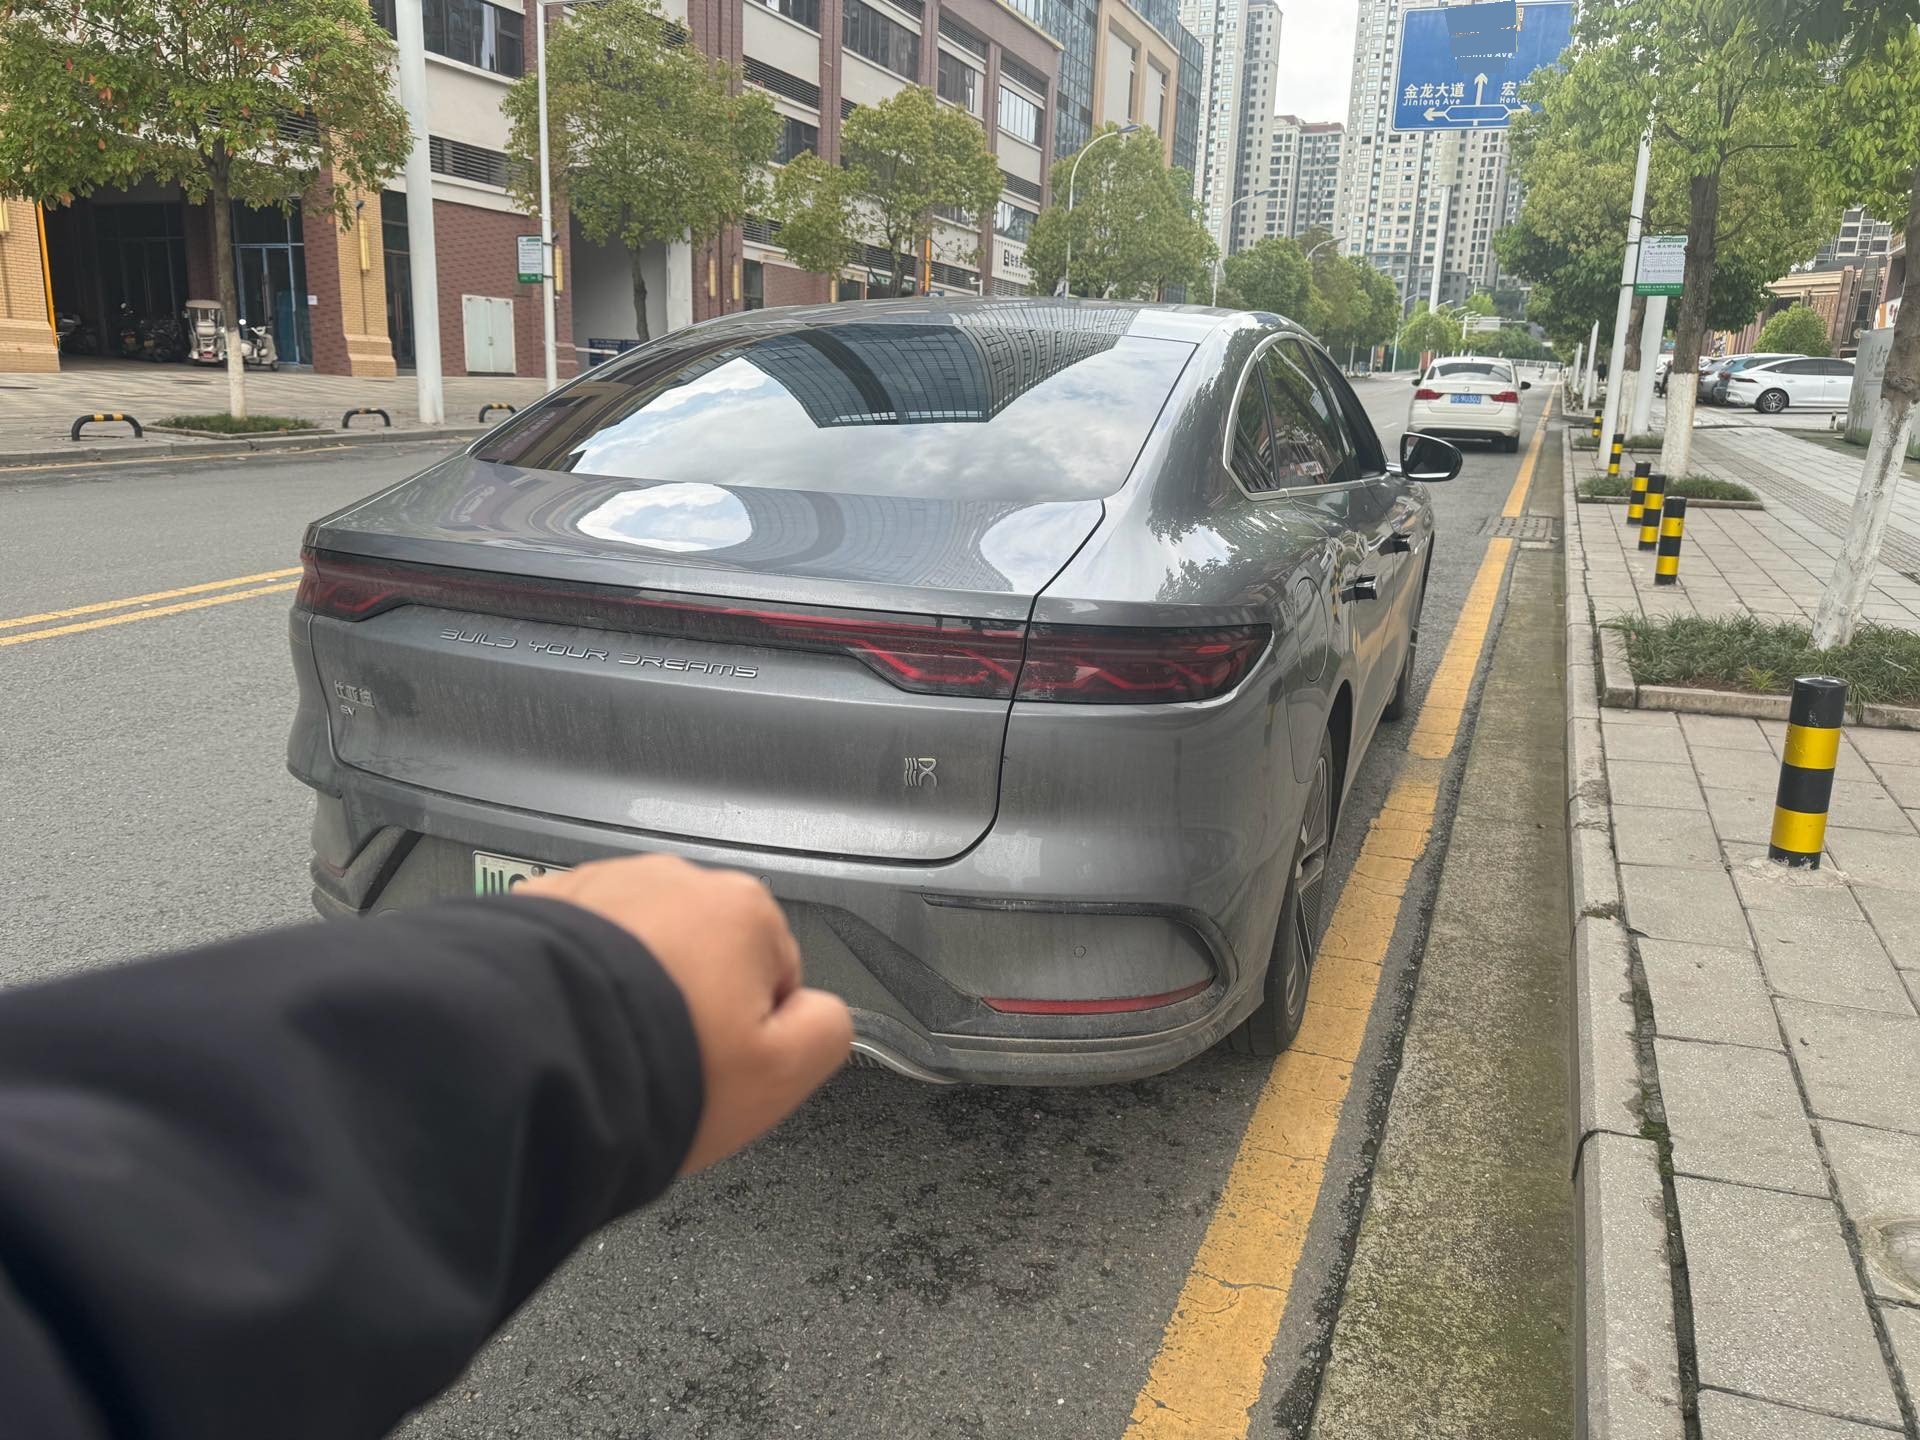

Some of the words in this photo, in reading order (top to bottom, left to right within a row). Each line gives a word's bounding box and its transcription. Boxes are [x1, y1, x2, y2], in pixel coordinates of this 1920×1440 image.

[1404, 82, 1465, 99] 金龙大道
[1402, 98, 1440, 107] Jinlong
[440, 628, 517, 649] BUILD
[528, 640, 608, 662] YOUR
[618, 652, 758, 678] DREAMS
